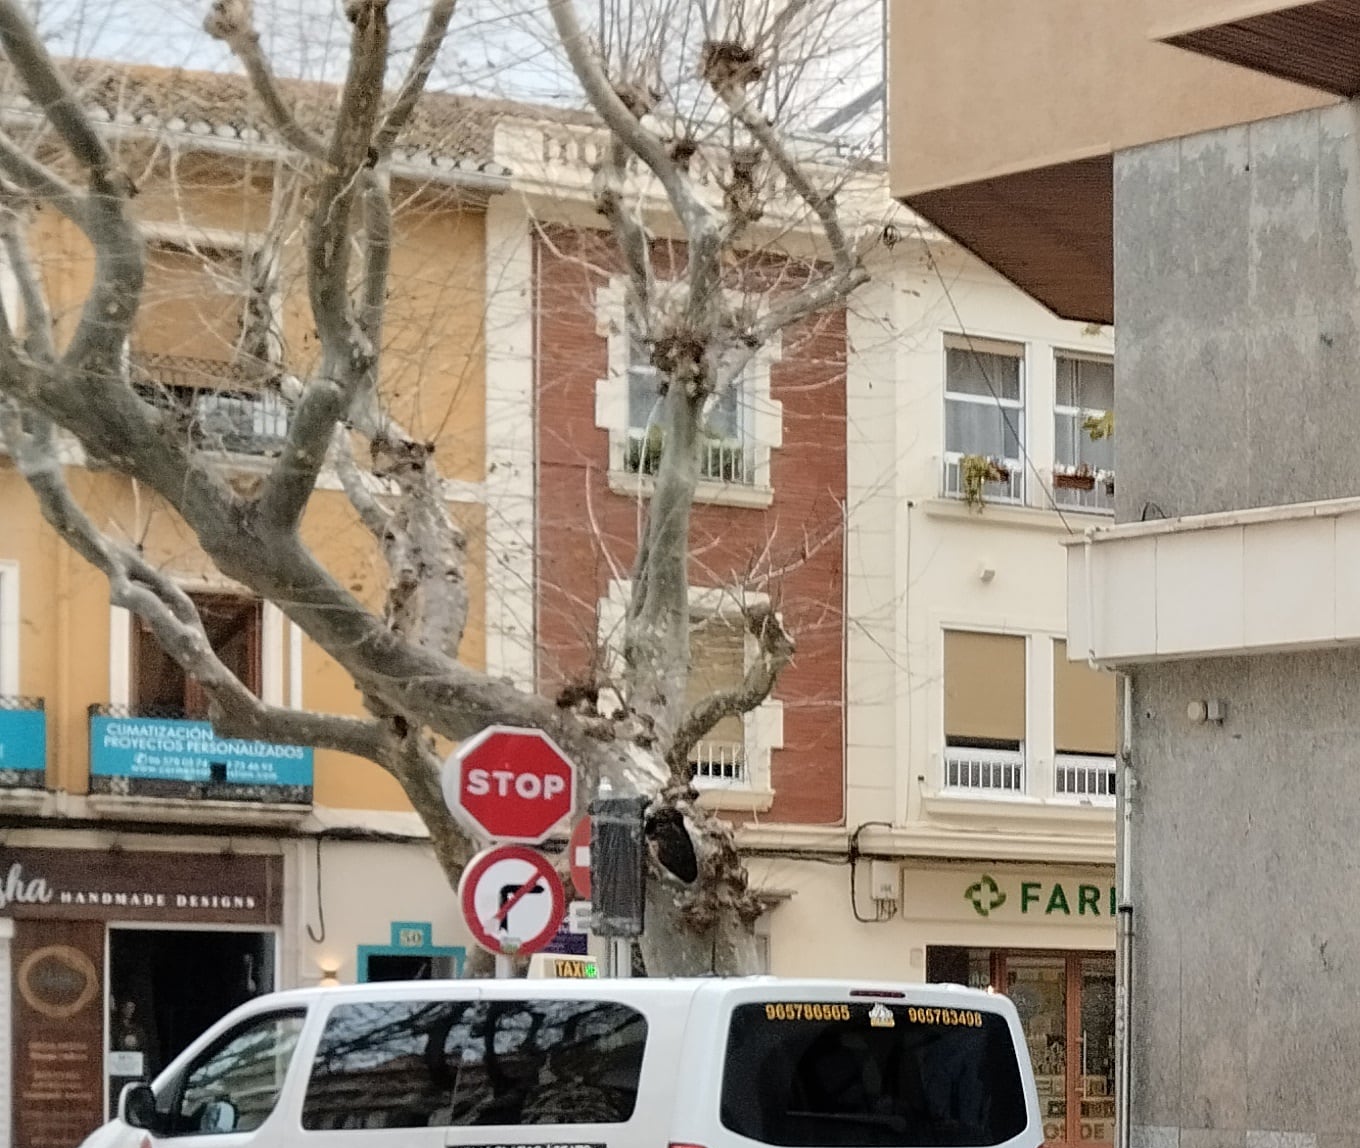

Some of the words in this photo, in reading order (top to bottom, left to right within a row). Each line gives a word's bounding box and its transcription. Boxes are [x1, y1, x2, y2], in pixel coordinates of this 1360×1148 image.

[104, 735, 184, 752] PROYECTOS
[187, 740, 304, 759] PERSONALIZADOS
[467, 768, 565, 800] STOP
[60, 891, 166, 906] HANDMADE
[176, 893, 256, 909] DESIGNS
[1020, 882, 1115, 916] FAR
[555, 960, 586, 978] TAXI
